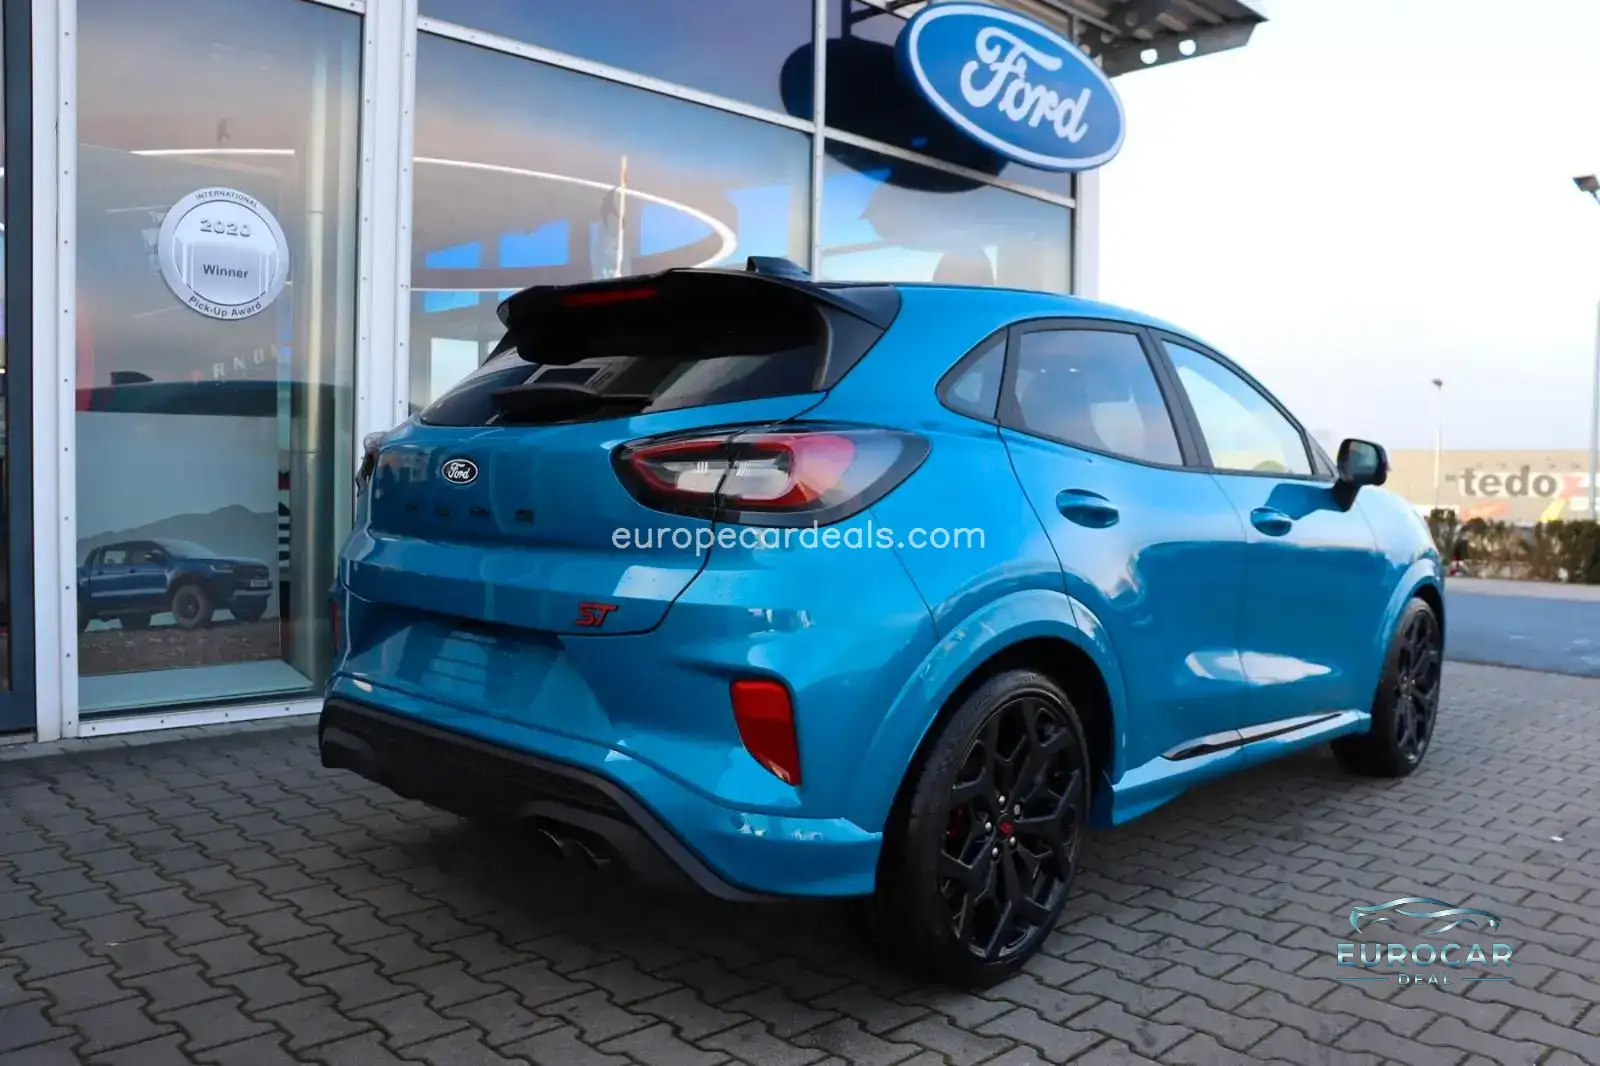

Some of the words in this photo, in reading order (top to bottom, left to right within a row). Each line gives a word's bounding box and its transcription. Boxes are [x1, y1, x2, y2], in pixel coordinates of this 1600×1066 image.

[960, 26, 1092, 143] Ford
[195, 190, 259, 209] INTERNATIONAL
[200, 219, 252, 238] 2020
[202, 263, 249, 279] Winner
[188, 295, 228, 318] Pick-Up
[231, 301, 262, 317] Award
[447, 462, 471, 479] Ford
[576, 602, 619, 627] ST
